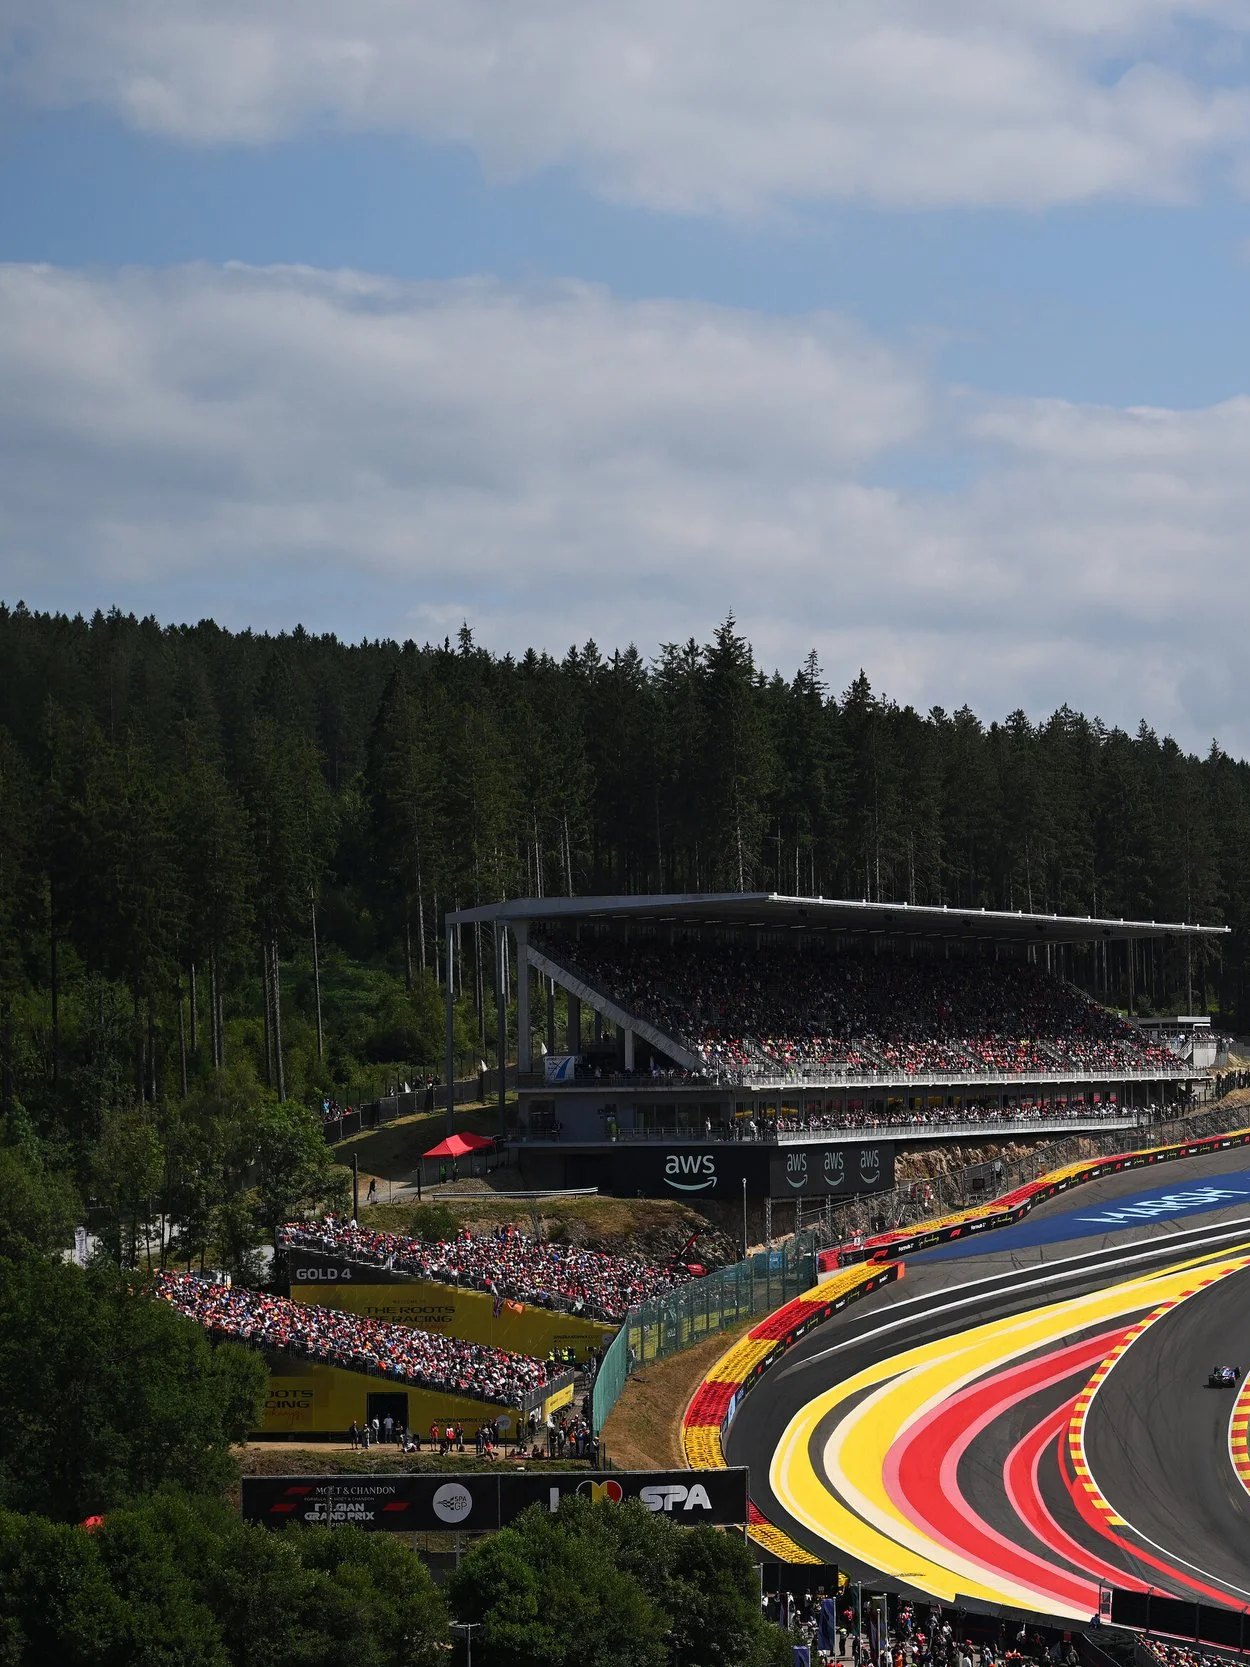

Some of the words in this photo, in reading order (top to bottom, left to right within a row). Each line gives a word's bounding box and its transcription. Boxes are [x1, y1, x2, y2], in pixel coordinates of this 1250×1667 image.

[665, 1155, 715, 1174] aws
[787, 1153, 807, 1172] aws
[824, 1151, 844, 1170] aws
[860, 1149, 879, 1168] aws
[1073, 1188, 1250, 1223] MARSH
[296, 1268, 338, 1281] GOLD
[341, 1268, 352, 1280] 4
[343, 1486, 350, 1495] &
[350, 1486, 396, 1495] CHANDON
[639, 1483, 712, 1512] SPA
[454, 1502, 468, 1511] GP
[304, 1512, 346, 1521] GRAND
[347, 1512, 376, 1521] PRIX
